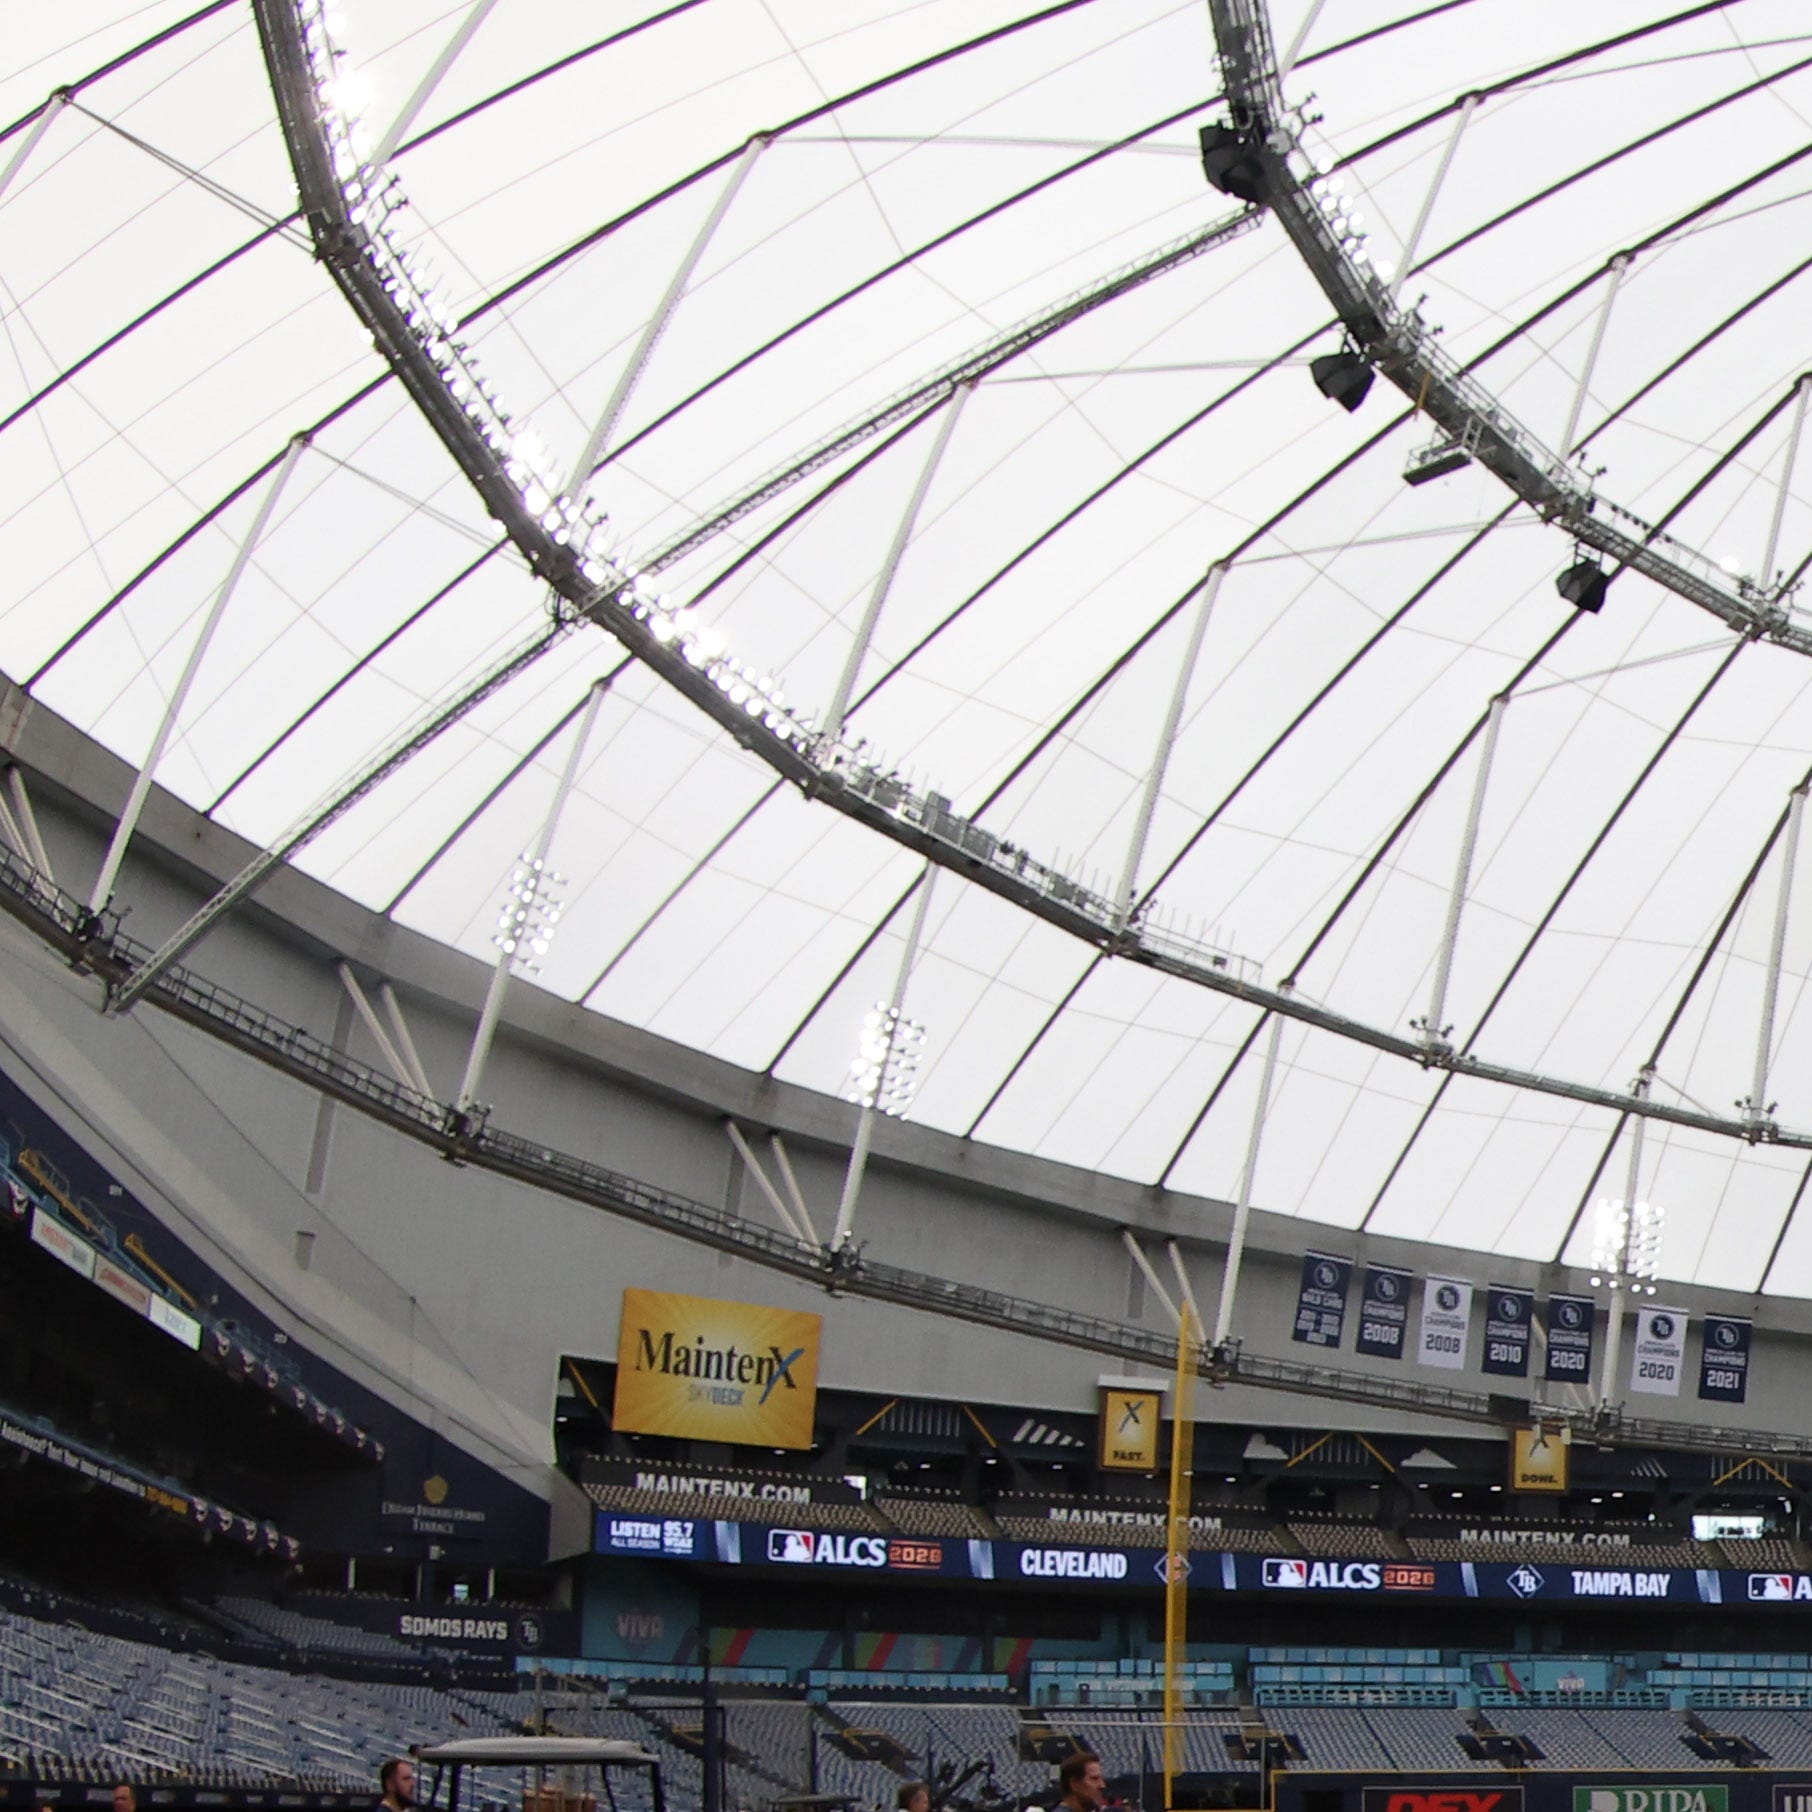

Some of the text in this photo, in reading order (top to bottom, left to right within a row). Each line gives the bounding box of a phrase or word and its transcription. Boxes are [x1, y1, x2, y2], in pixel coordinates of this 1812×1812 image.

[1363, 1322, 1400, 1345] 2008
[1425, 1334, 1461, 1354] 2008
[1490, 1343, 1522, 1363] 2010
[1551, 1350, 1585, 1370] 2020
[635, 1329, 805, 1405] MaintenX
[1639, 1361, 1675, 1381] 2020
[1706, 1370, 1740, 1389] 2021
[610, 1520, 694, 1539] LISTEN 95.7
[815, 1535, 888, 1567] ALCS
[1021, 1549, 1128, 1579] CLEVELAND
[1308, 1562, 1381, 1589] ALCS
[1571, 1570, 1634, 1597] TAMPA
[1635, 1573, 1671, 1597] BAY
[400, 1614, 463, 1638] SOMOS
[463, 1618, 508, 1641] RAYS
[617, 1613, 665, 1639] VIVA
